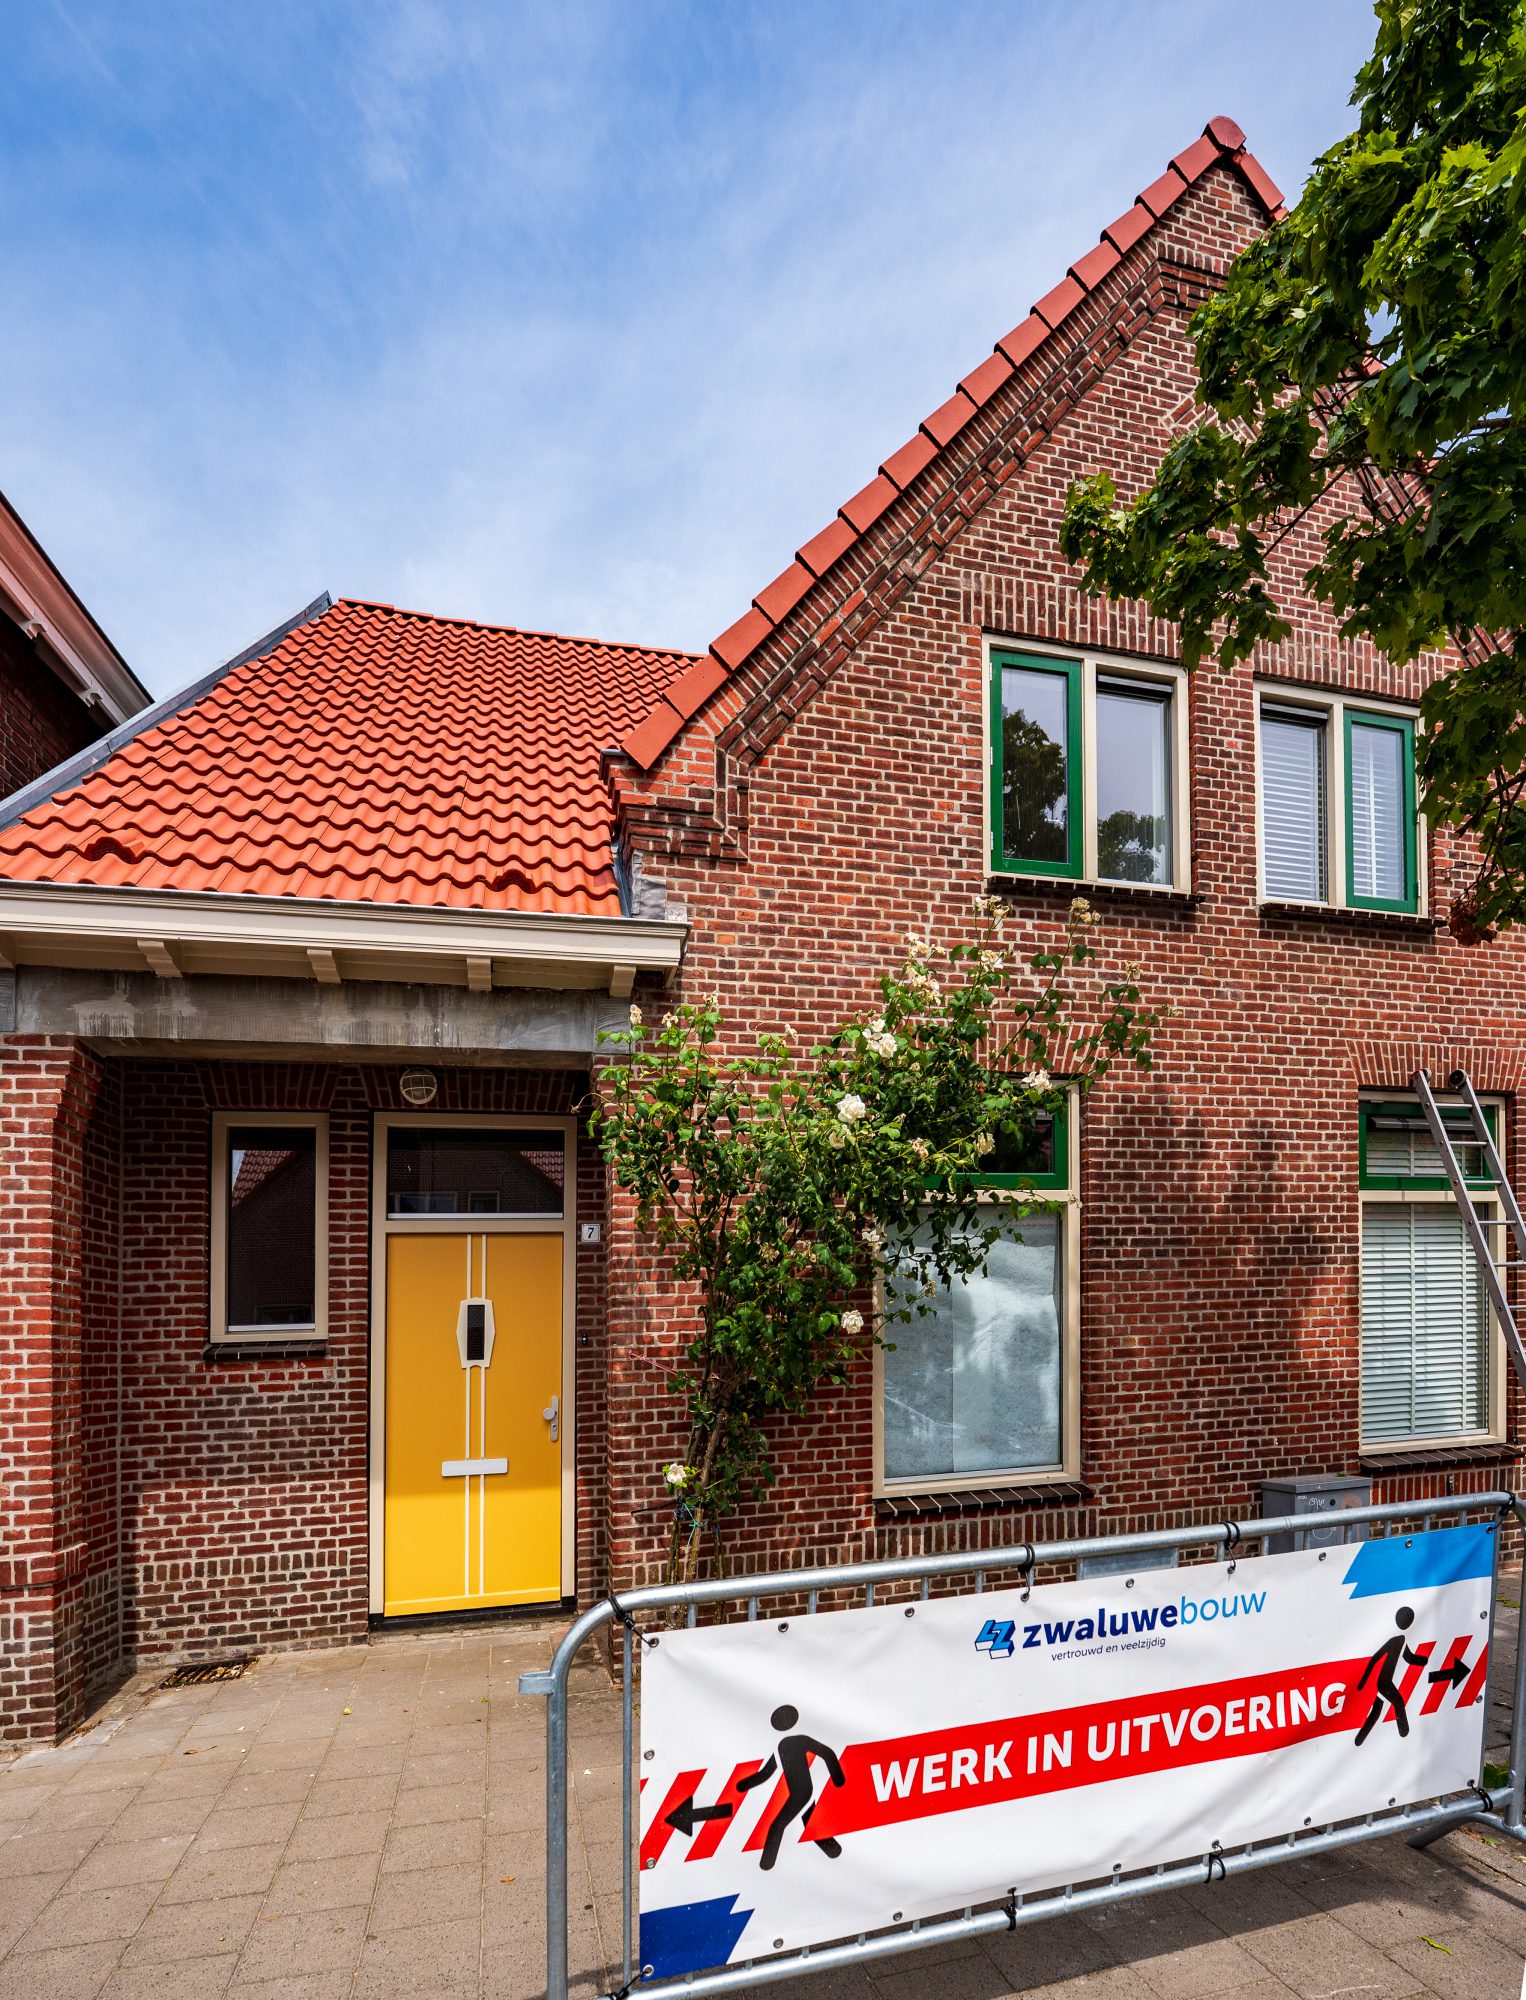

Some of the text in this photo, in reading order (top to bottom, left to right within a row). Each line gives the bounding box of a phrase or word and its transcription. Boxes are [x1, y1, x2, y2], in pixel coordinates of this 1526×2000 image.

[588, 1227, 594, 1239] 7
[1022, 1591, 1267, 1649] zwaluwebouw
[1051, 1636, 1166, 1661] vertrouwd en veelzijdig
[870, 1682, 1347, 1803] WERK IN UITVOERING
